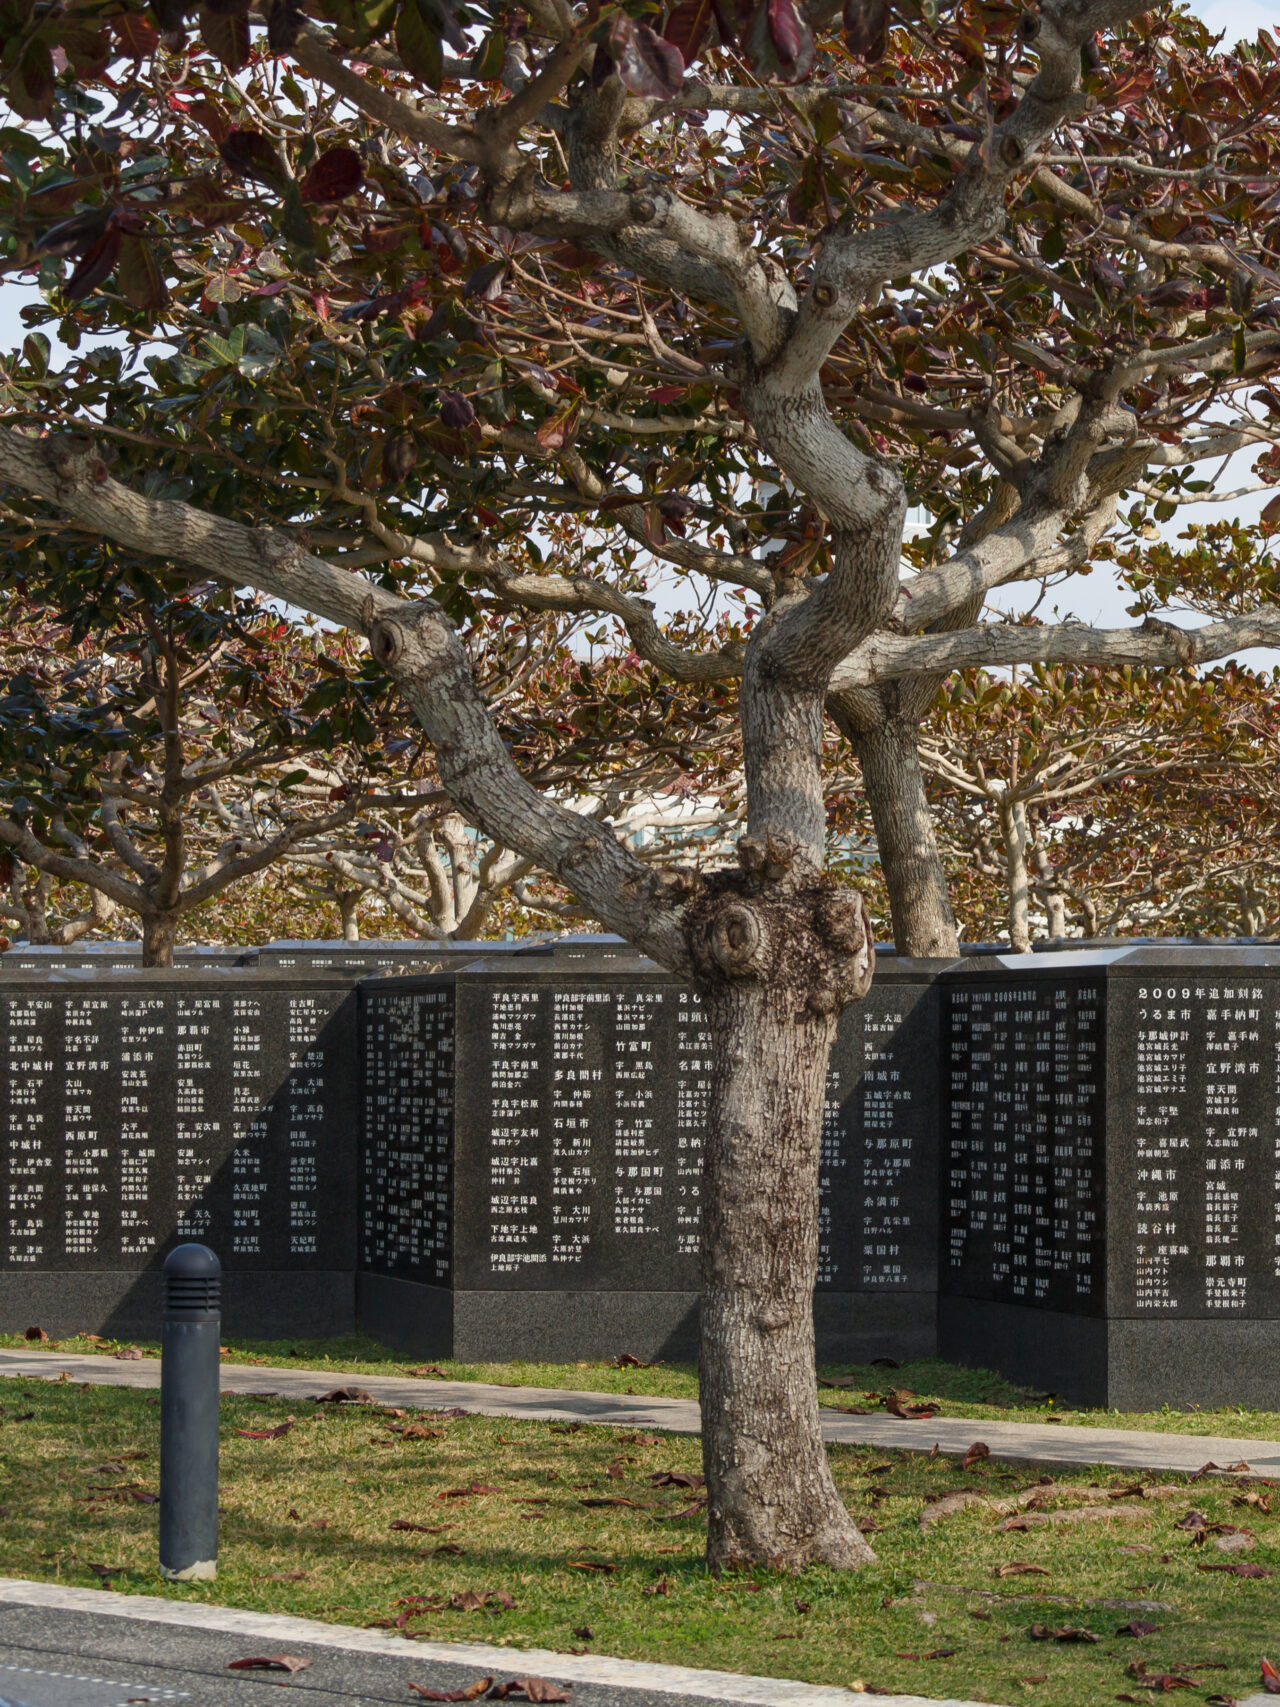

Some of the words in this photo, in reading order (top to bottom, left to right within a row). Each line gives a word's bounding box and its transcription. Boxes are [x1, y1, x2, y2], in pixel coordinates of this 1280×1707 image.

[493, 993, 539, 1002] 平良字西里
[555, 994, 610, 1002] 伊良部字前里添
[1138, 987, 1263, 1000] 2009年追加刻銘
[1140, 1009, 1191, 1020] うるま市
[1207, 1009, 1260, 1020] 嘉手納町
[178, 1026, 209, 1035] 那覇市
[234, 1026, 249, 1034] 小禄
[1138, 1031, 1189, 1040] 与那城伊計
[616, 1041, 651, 1051] 竹富町
[122, 1052, 153, 1061] 浦添市
[10, 1061, 53, 1071] 北中城村
[66, 1061, 109, 1070] 宜野湾市
[234, 1061, 250, 1069] 垣花
[493, 1061, 538, 1069] 平良字前里
[679, 1060, 712, 1070] 名護市
[1207, 1063, 1259, 1073] 宜野湾市
[555, 1070, 602, 1080] 多良間村
[864, 1071, 900, 1080] 南城市
[1207, 1085, 1236, 1094] 普天間
[865, 1091, 910, 1099] 玉城字糸数
[492, 1099, 538, 1108] 平良字松原
[1206, 1096, 1237, 1104] 宮城ヨシ
[554, 1119, 588, 1128] 石垣市
[66, 1131, 97, 1140] 西原町
[492, 1128, 538, 1137] 城辺字友利
[10, 1140, 41, 1149] 中城村
[865, 1139, 912, 1149] 与那原町
[491, 1157, 537, 1166] 城辺字比嘉
[1206, 1159, 1245, 1170] 浦添市
[616, 1167, 663, 1177] 与那国町
[1138, 1169, 1176, 1180] 沖縄市
[1206, 1181, 1226, 1190] 宮城
[491, 1196, 537, 1204] 城辺字保良
[864, 1197, 899, 1206] 糸満市
[491, 1225, 537, 1233] 下地字上地
[1138, 1223, 1176, 1234] 読谷村
[864, 1245, 899, 1255] 粟国村
[1206, 1255, 1244, 1266] 那覇市
[1206, 1278, 1246, 1287] 崇元寺町
